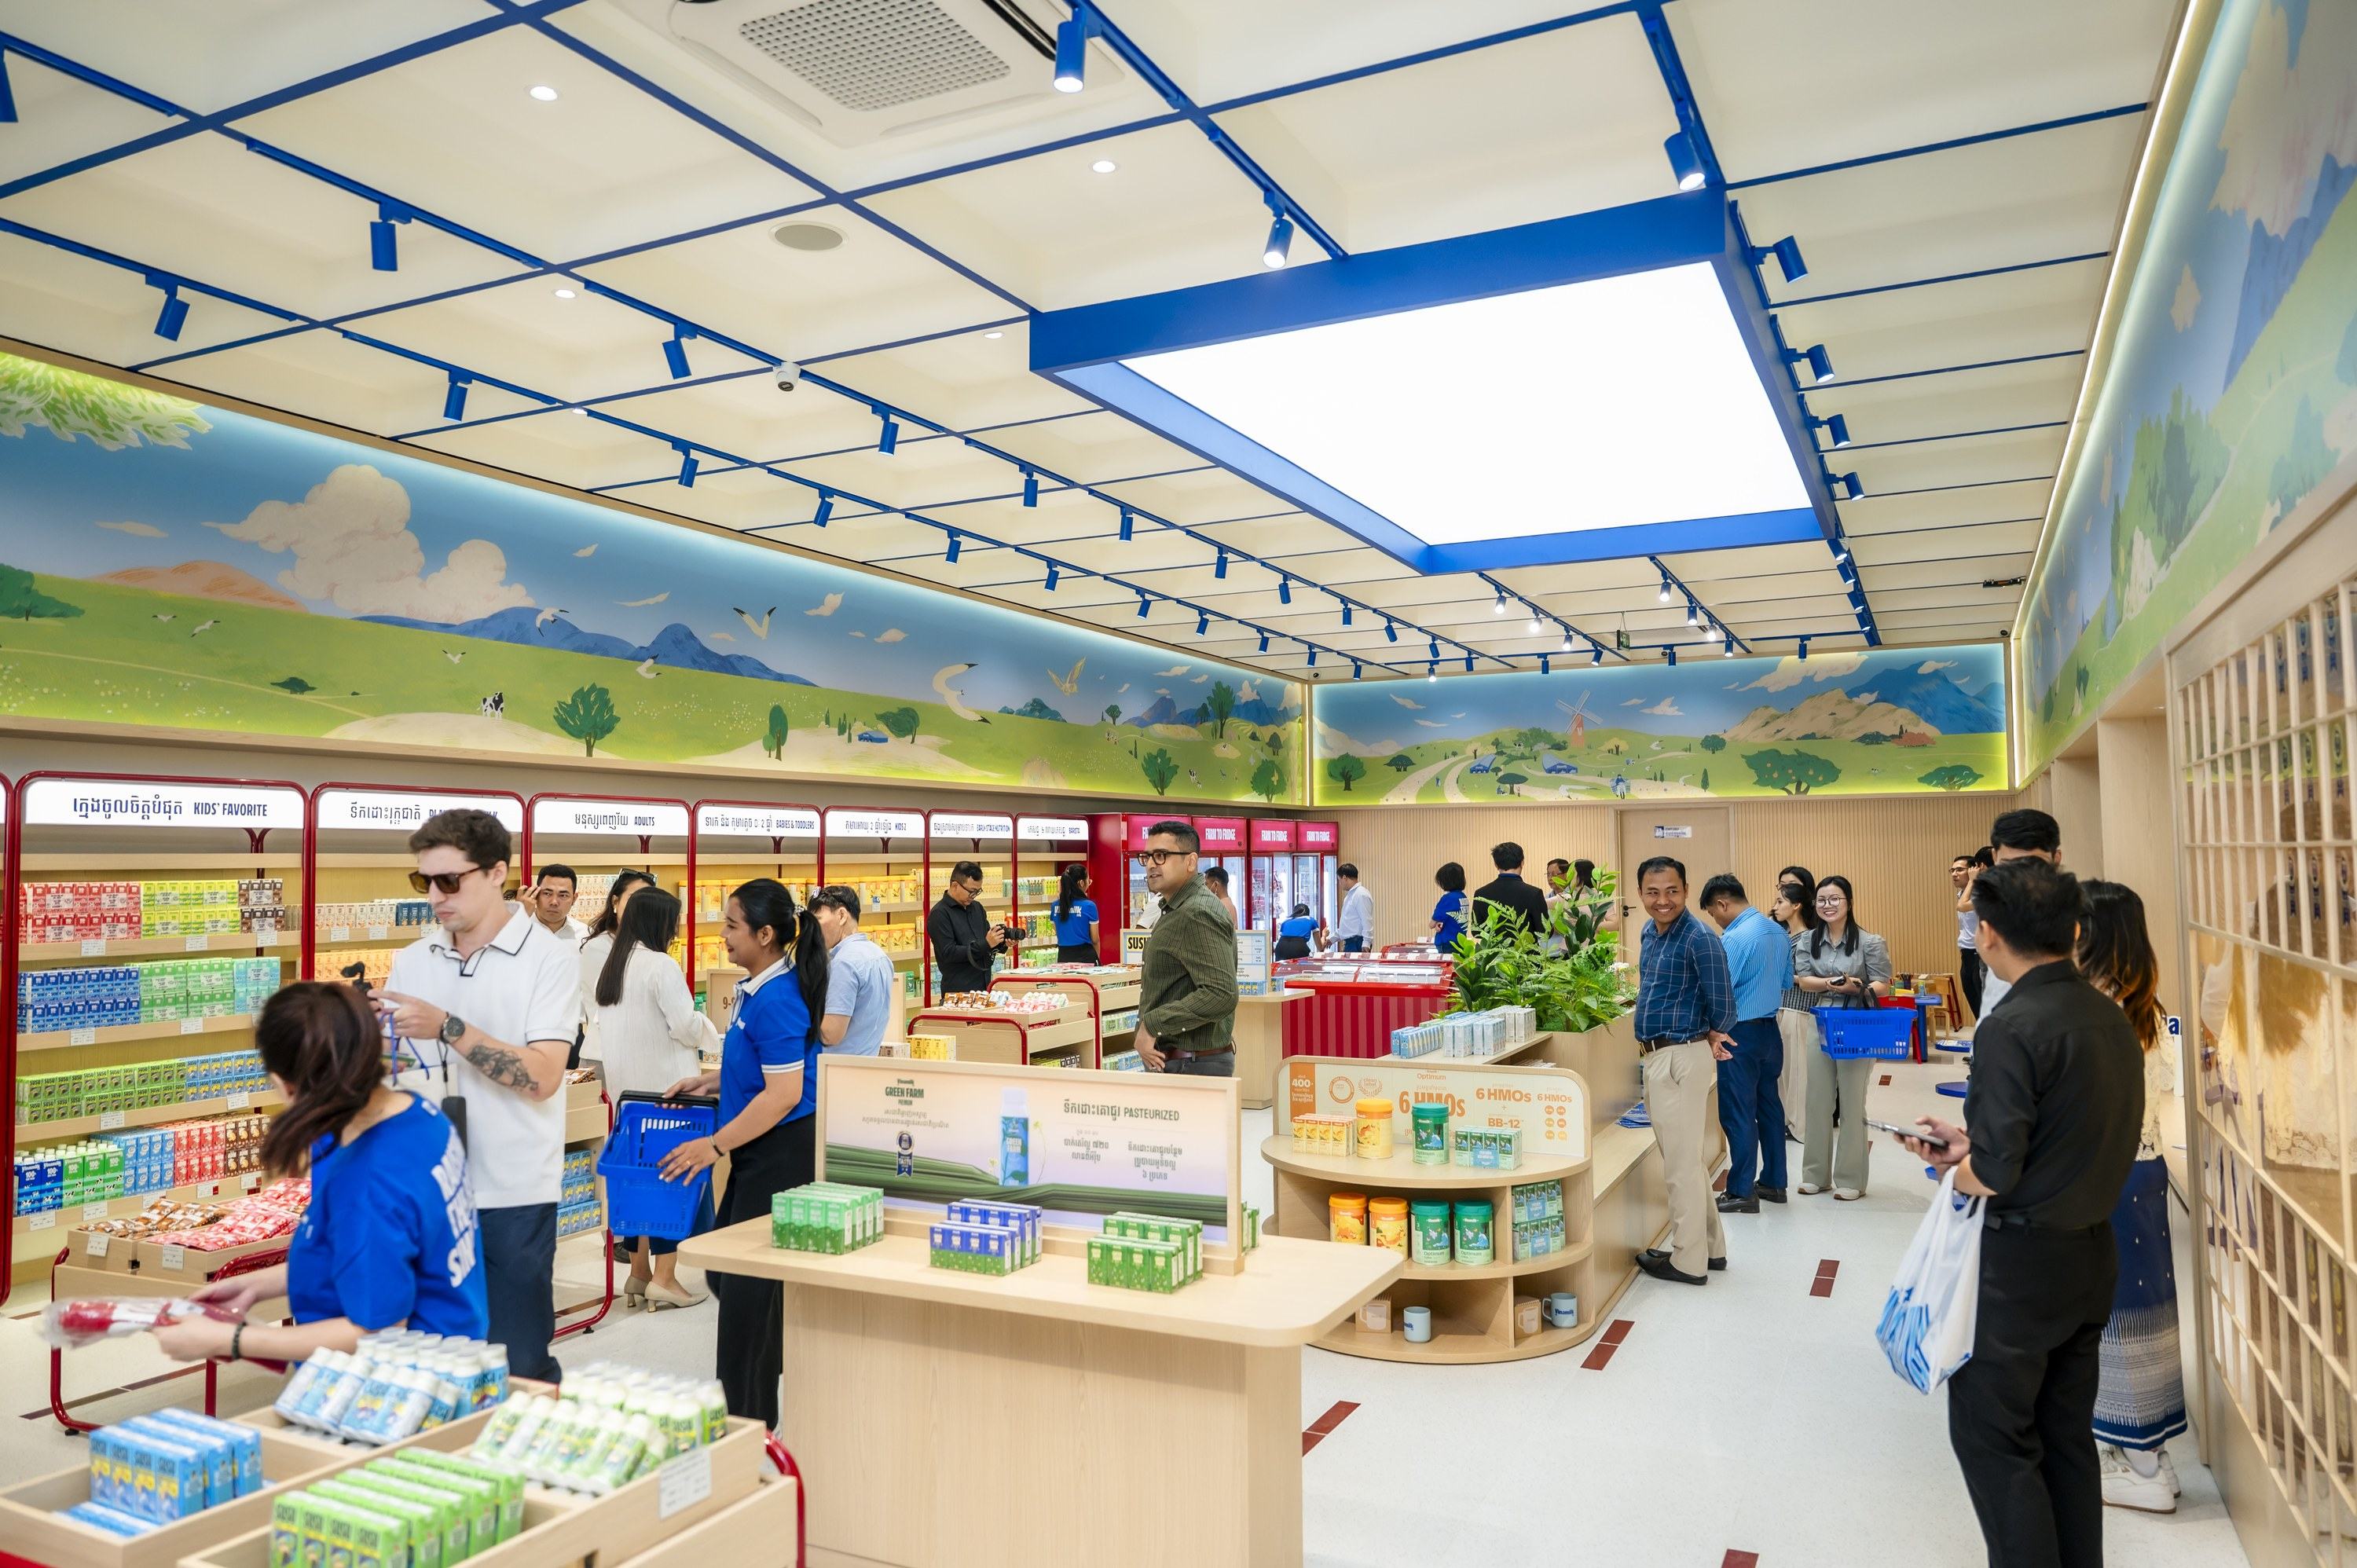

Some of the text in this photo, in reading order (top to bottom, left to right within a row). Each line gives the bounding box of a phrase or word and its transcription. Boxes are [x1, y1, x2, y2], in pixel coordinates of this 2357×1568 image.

[222, 803, 267, 816] FAVORITE
[635, 816, 654, 826] ADULTS
[776, 820, 790, 829] BABIES
[795, 821, 814, 830] TODDLERS
[1205, 828, 1217, 840] FARM
[1222, 828, 1236, 840] FRIDGE
[885, 1086, 924, 1098] GREEN FARM
[1475, 1088, 1531, 1102] 6 HMOs
[1399, 1091, 1410, 1114] 6
[1544, 1094, 1572, 1103] HMOs
[1124, 1107, 1179, 1121] PASTEURIZED
[1488, 1118, 1520, 1128] BB-12
